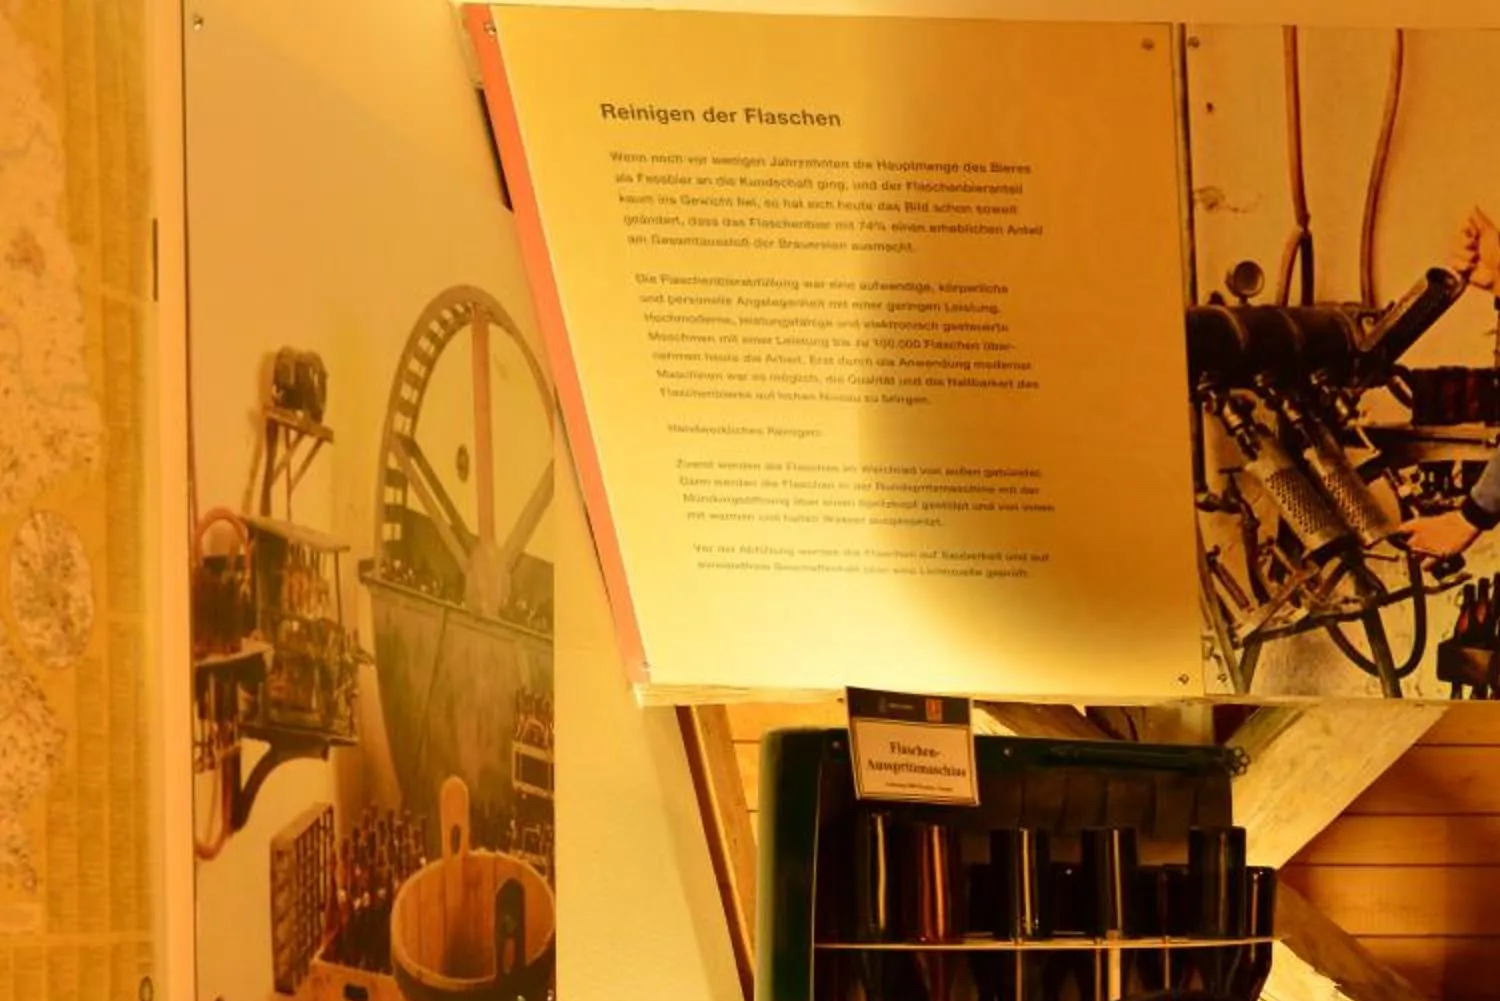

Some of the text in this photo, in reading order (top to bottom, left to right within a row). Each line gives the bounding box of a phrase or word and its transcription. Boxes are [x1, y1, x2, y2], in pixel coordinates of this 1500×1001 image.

[600, 102, 842, 126] Reinigen der Flaschen
